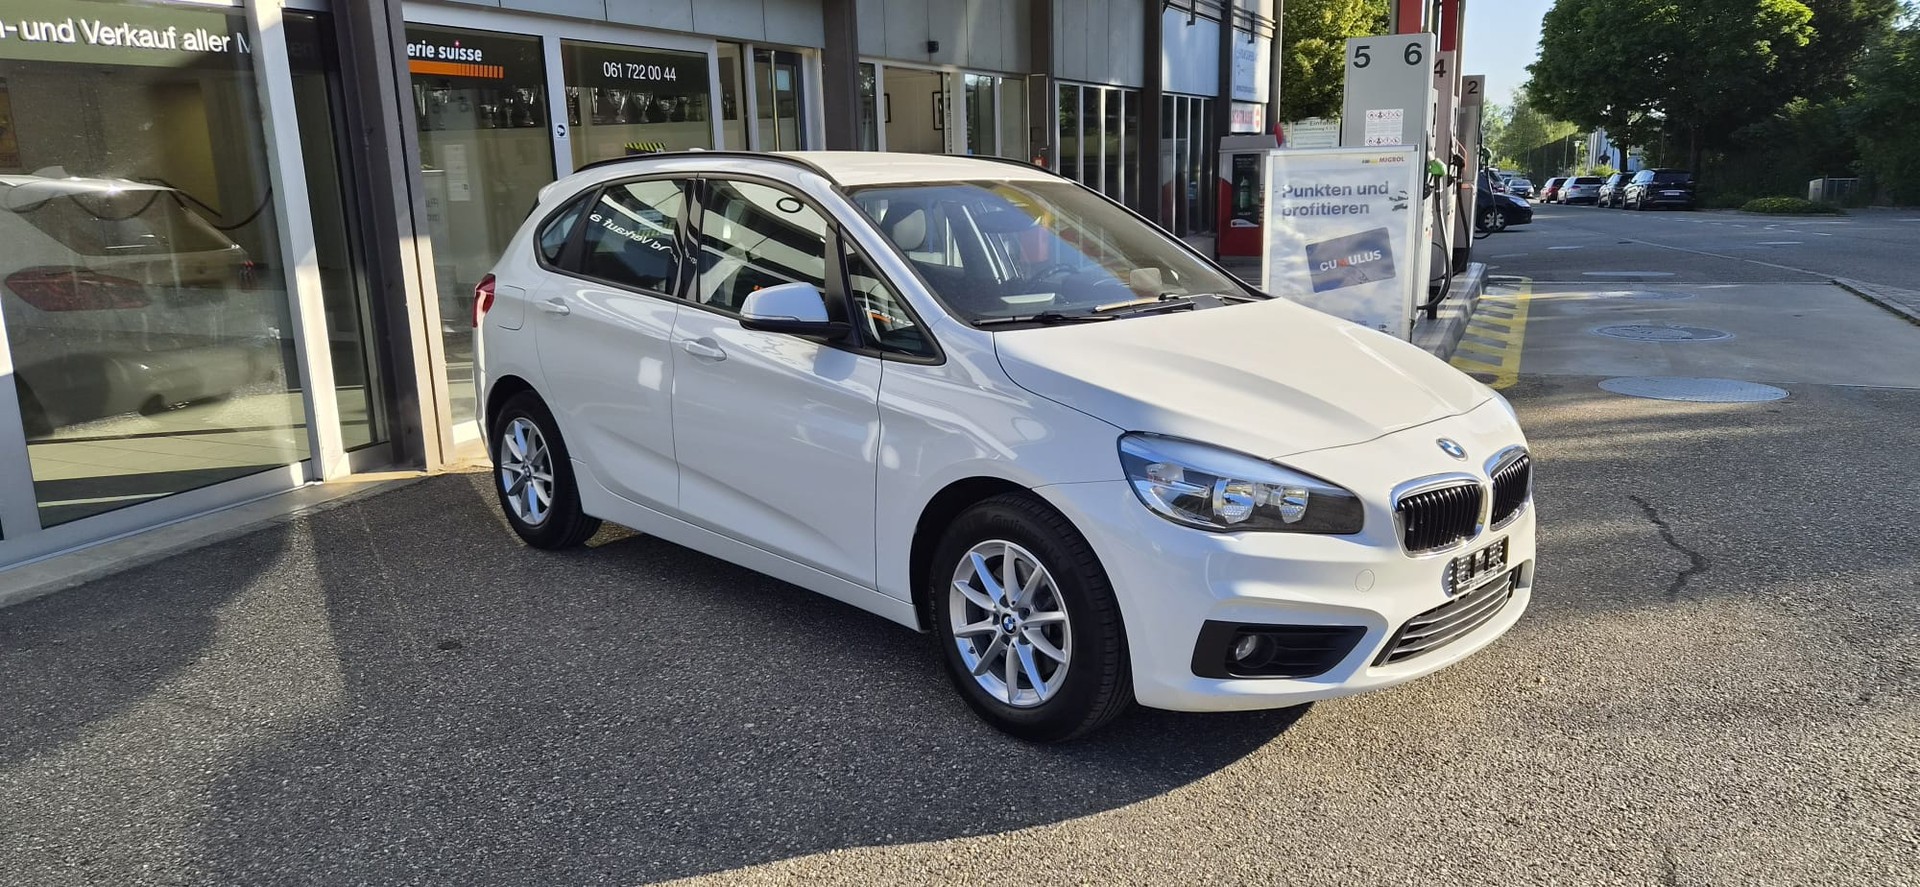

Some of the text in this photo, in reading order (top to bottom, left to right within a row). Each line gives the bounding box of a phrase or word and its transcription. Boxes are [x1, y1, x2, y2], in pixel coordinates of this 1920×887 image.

[80, 18, 177, 49] Verkauf
[183, 27, 231, 53] aller
[438, 41, 483, 62] suisse
[1353, 42, 1423, 69] 5 6
[603, 61, 677, 82] 061 722 00 44
[1434, 59, 1447, 78] 4
[1467, 80, 1478, 95] 2
[1282, 181, 1389, 198] Punkten und
[1282, 202, 1370, 220] profitieren
